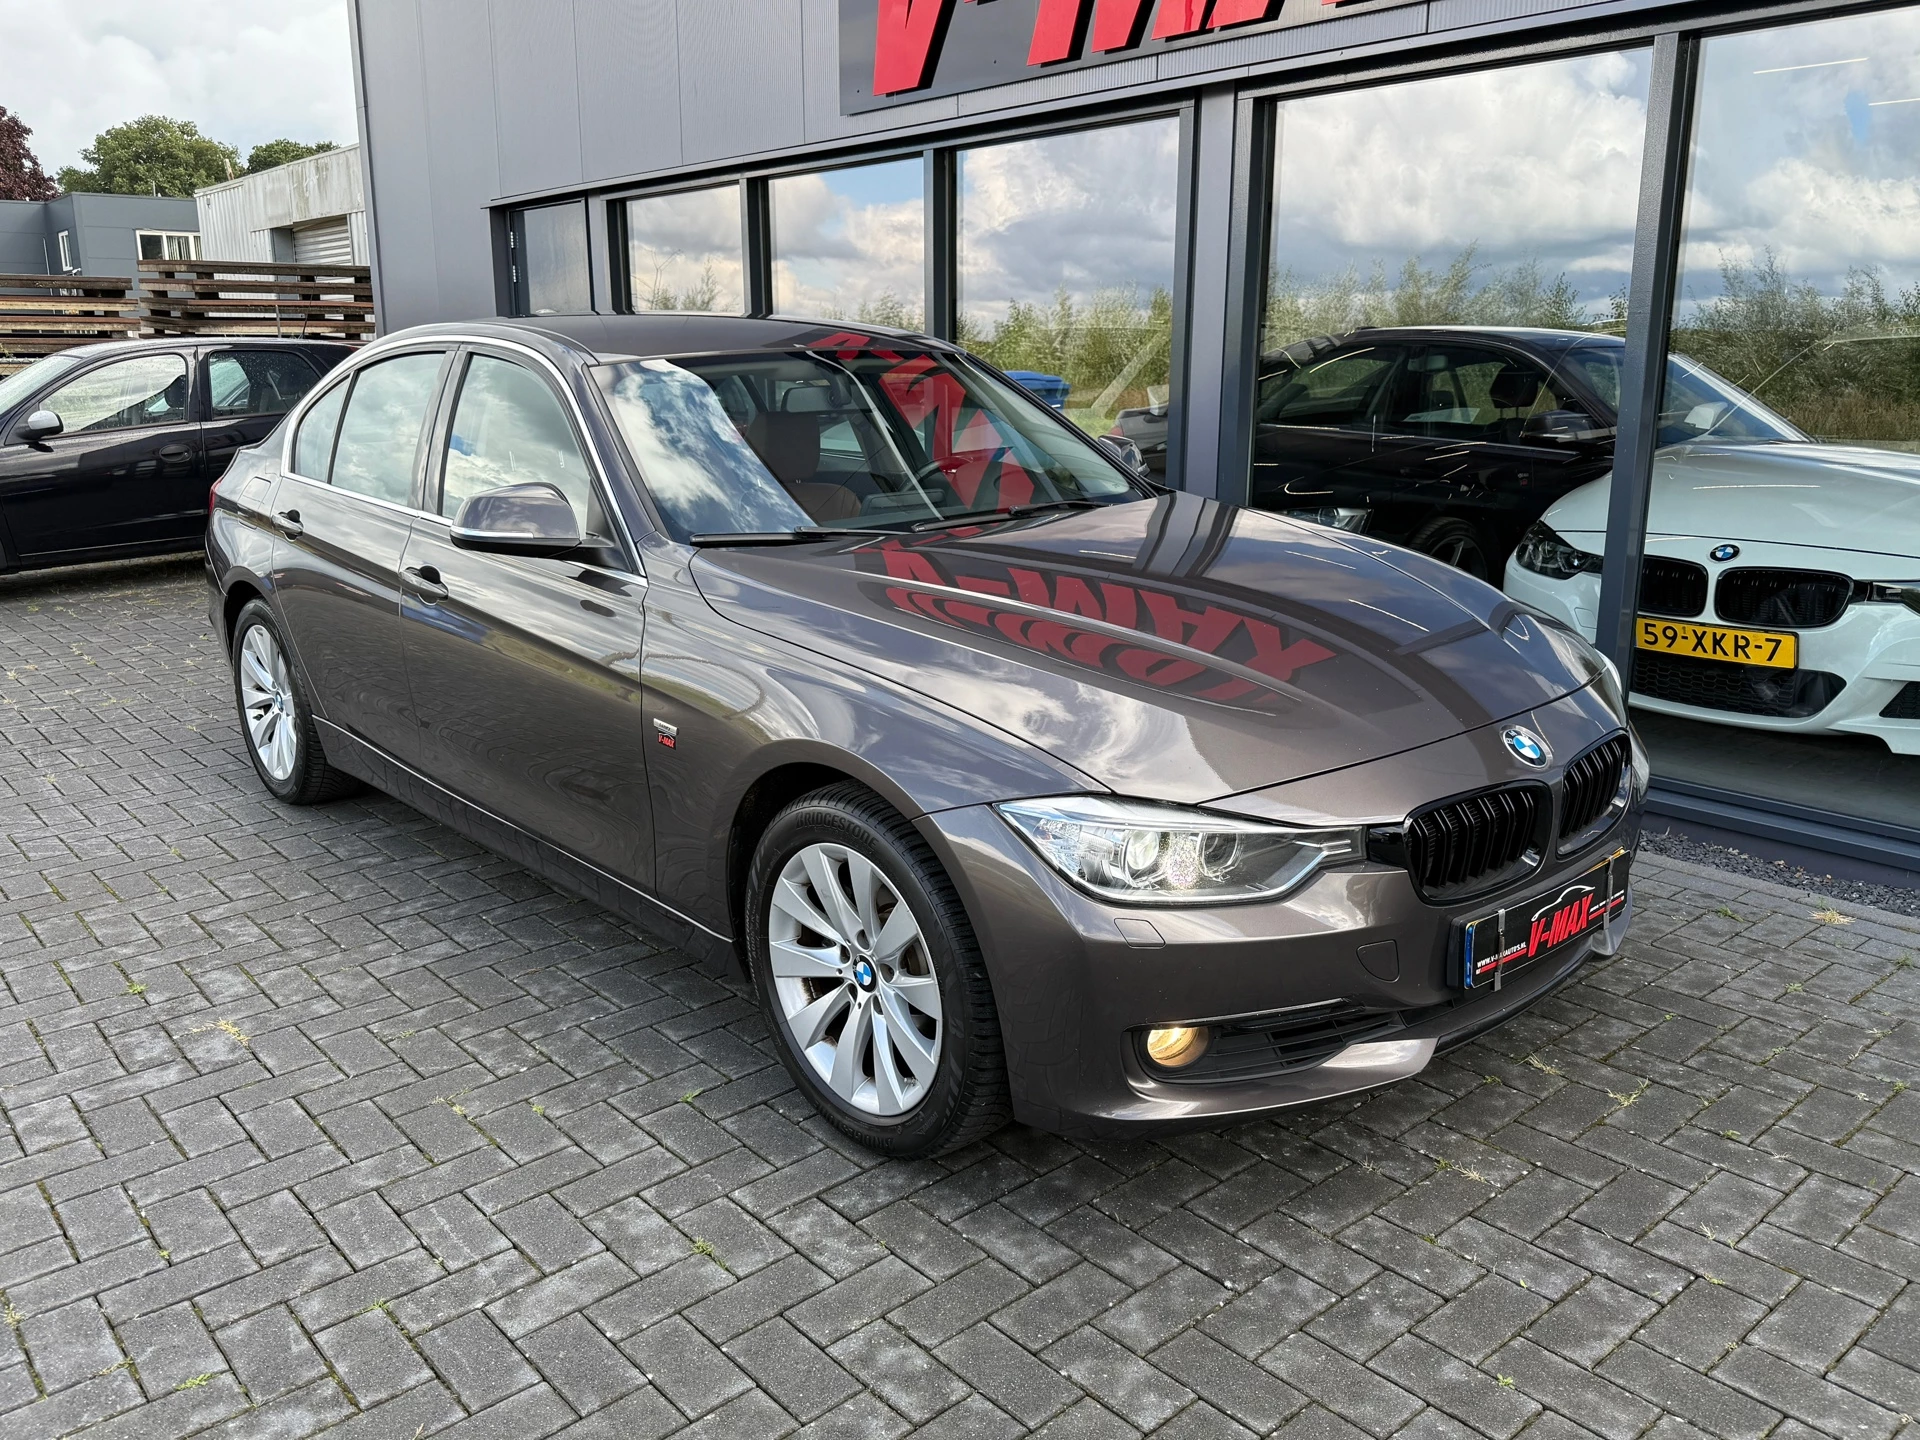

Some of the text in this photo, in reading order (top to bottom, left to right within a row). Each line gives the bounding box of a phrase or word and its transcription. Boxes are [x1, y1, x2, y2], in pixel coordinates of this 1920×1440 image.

[1643, 622, 1782, 662] 59-XKR-7
[796, 811, 879, 849] BRIDGESTONE
[1528, 893, 1594, 957] V-MAX
